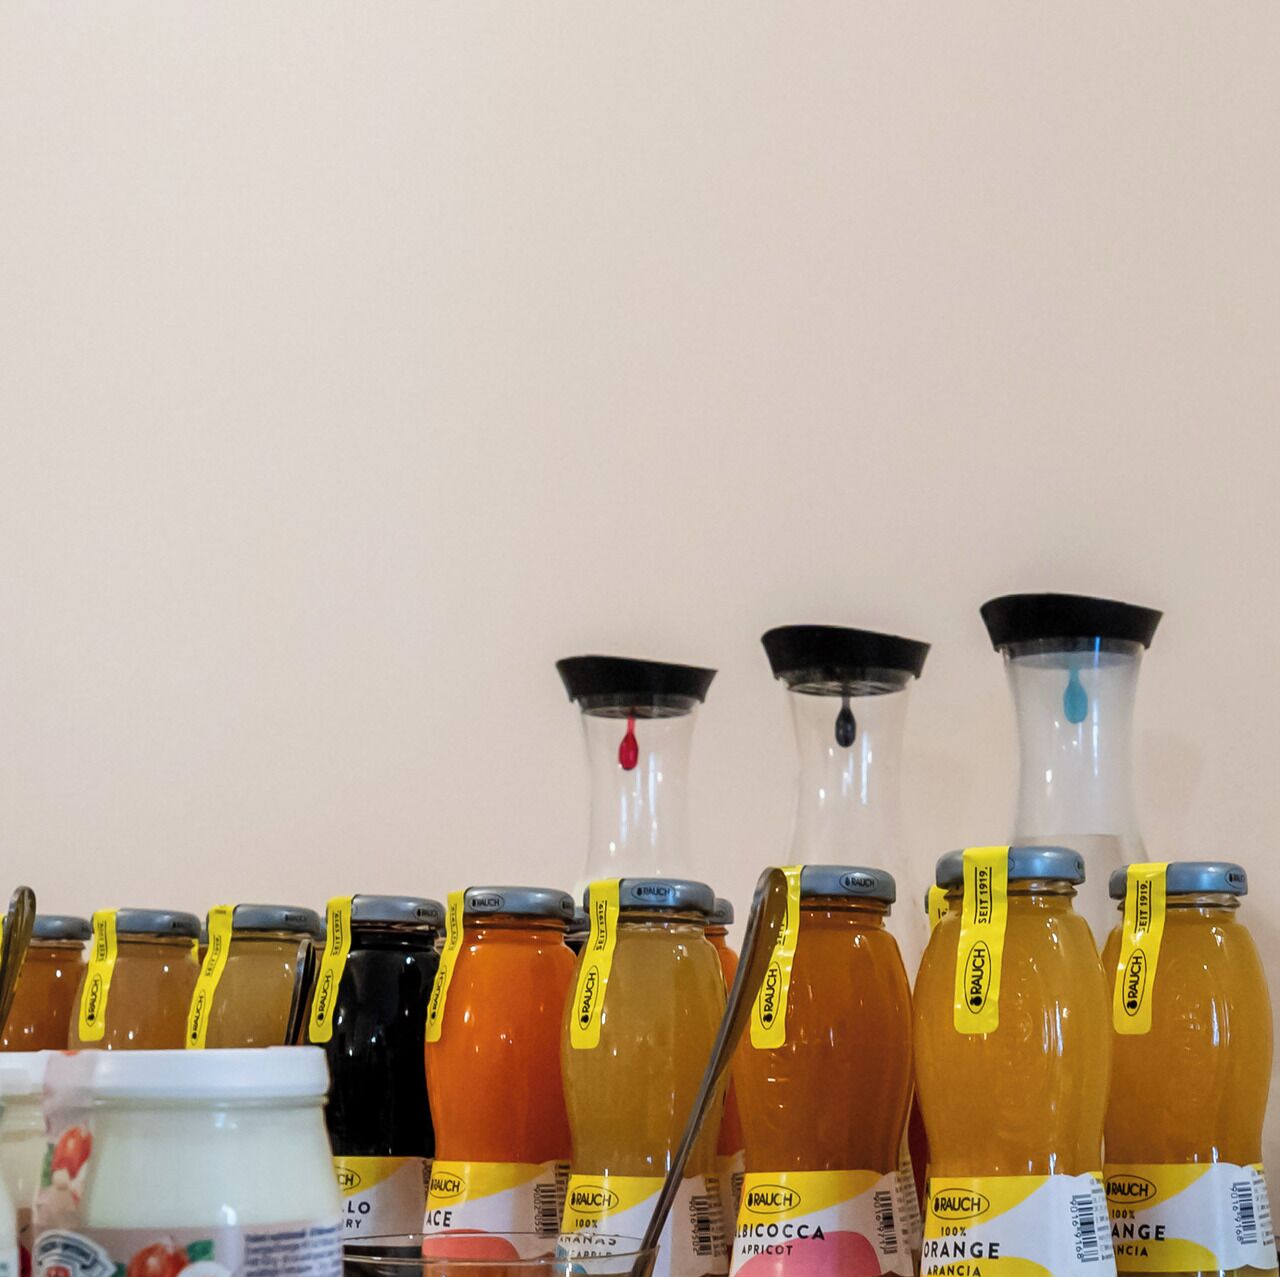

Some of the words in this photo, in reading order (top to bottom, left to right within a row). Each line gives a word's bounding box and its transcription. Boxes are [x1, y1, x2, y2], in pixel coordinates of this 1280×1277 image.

[851, 877, 875, 889] RAUCH
[979, 867, 989, 895] 1919.
[642, 886, 671, 897] RAUCH
[978, 900, 989, 924] SEIT
[970, 949, 986, 996] RAUCH
[1128, 956, 1143, 999] RAUCH
[582, 972, 596, 1015] RAUCH
[764, 968, 778, 1012] RAUCH
[1111, 1182, 1149, 1197] RAUCH
[576, 1191, 612, 1208] RAUCH
[753, 1193, 793, 1207] RAUCH
[940, 1196, 982, 1212] RAUCH
[426, 1210, 453, 1228] ACE
[1111, 1209, 1136, 1219] 100%
[575, 1218, 598, 1229] 100%
[736, 1223, 825, 1241] LBICOCCA
[941, 1225, 967, 1237] 100%
[1111, 1223, 1166, 1242] ANGE
[741, 1244, 793, 1256] APRICOT
[923, 1241, 1000, 1260] ORANGE
[927, 1264, 982, 1277] ARANCIA
